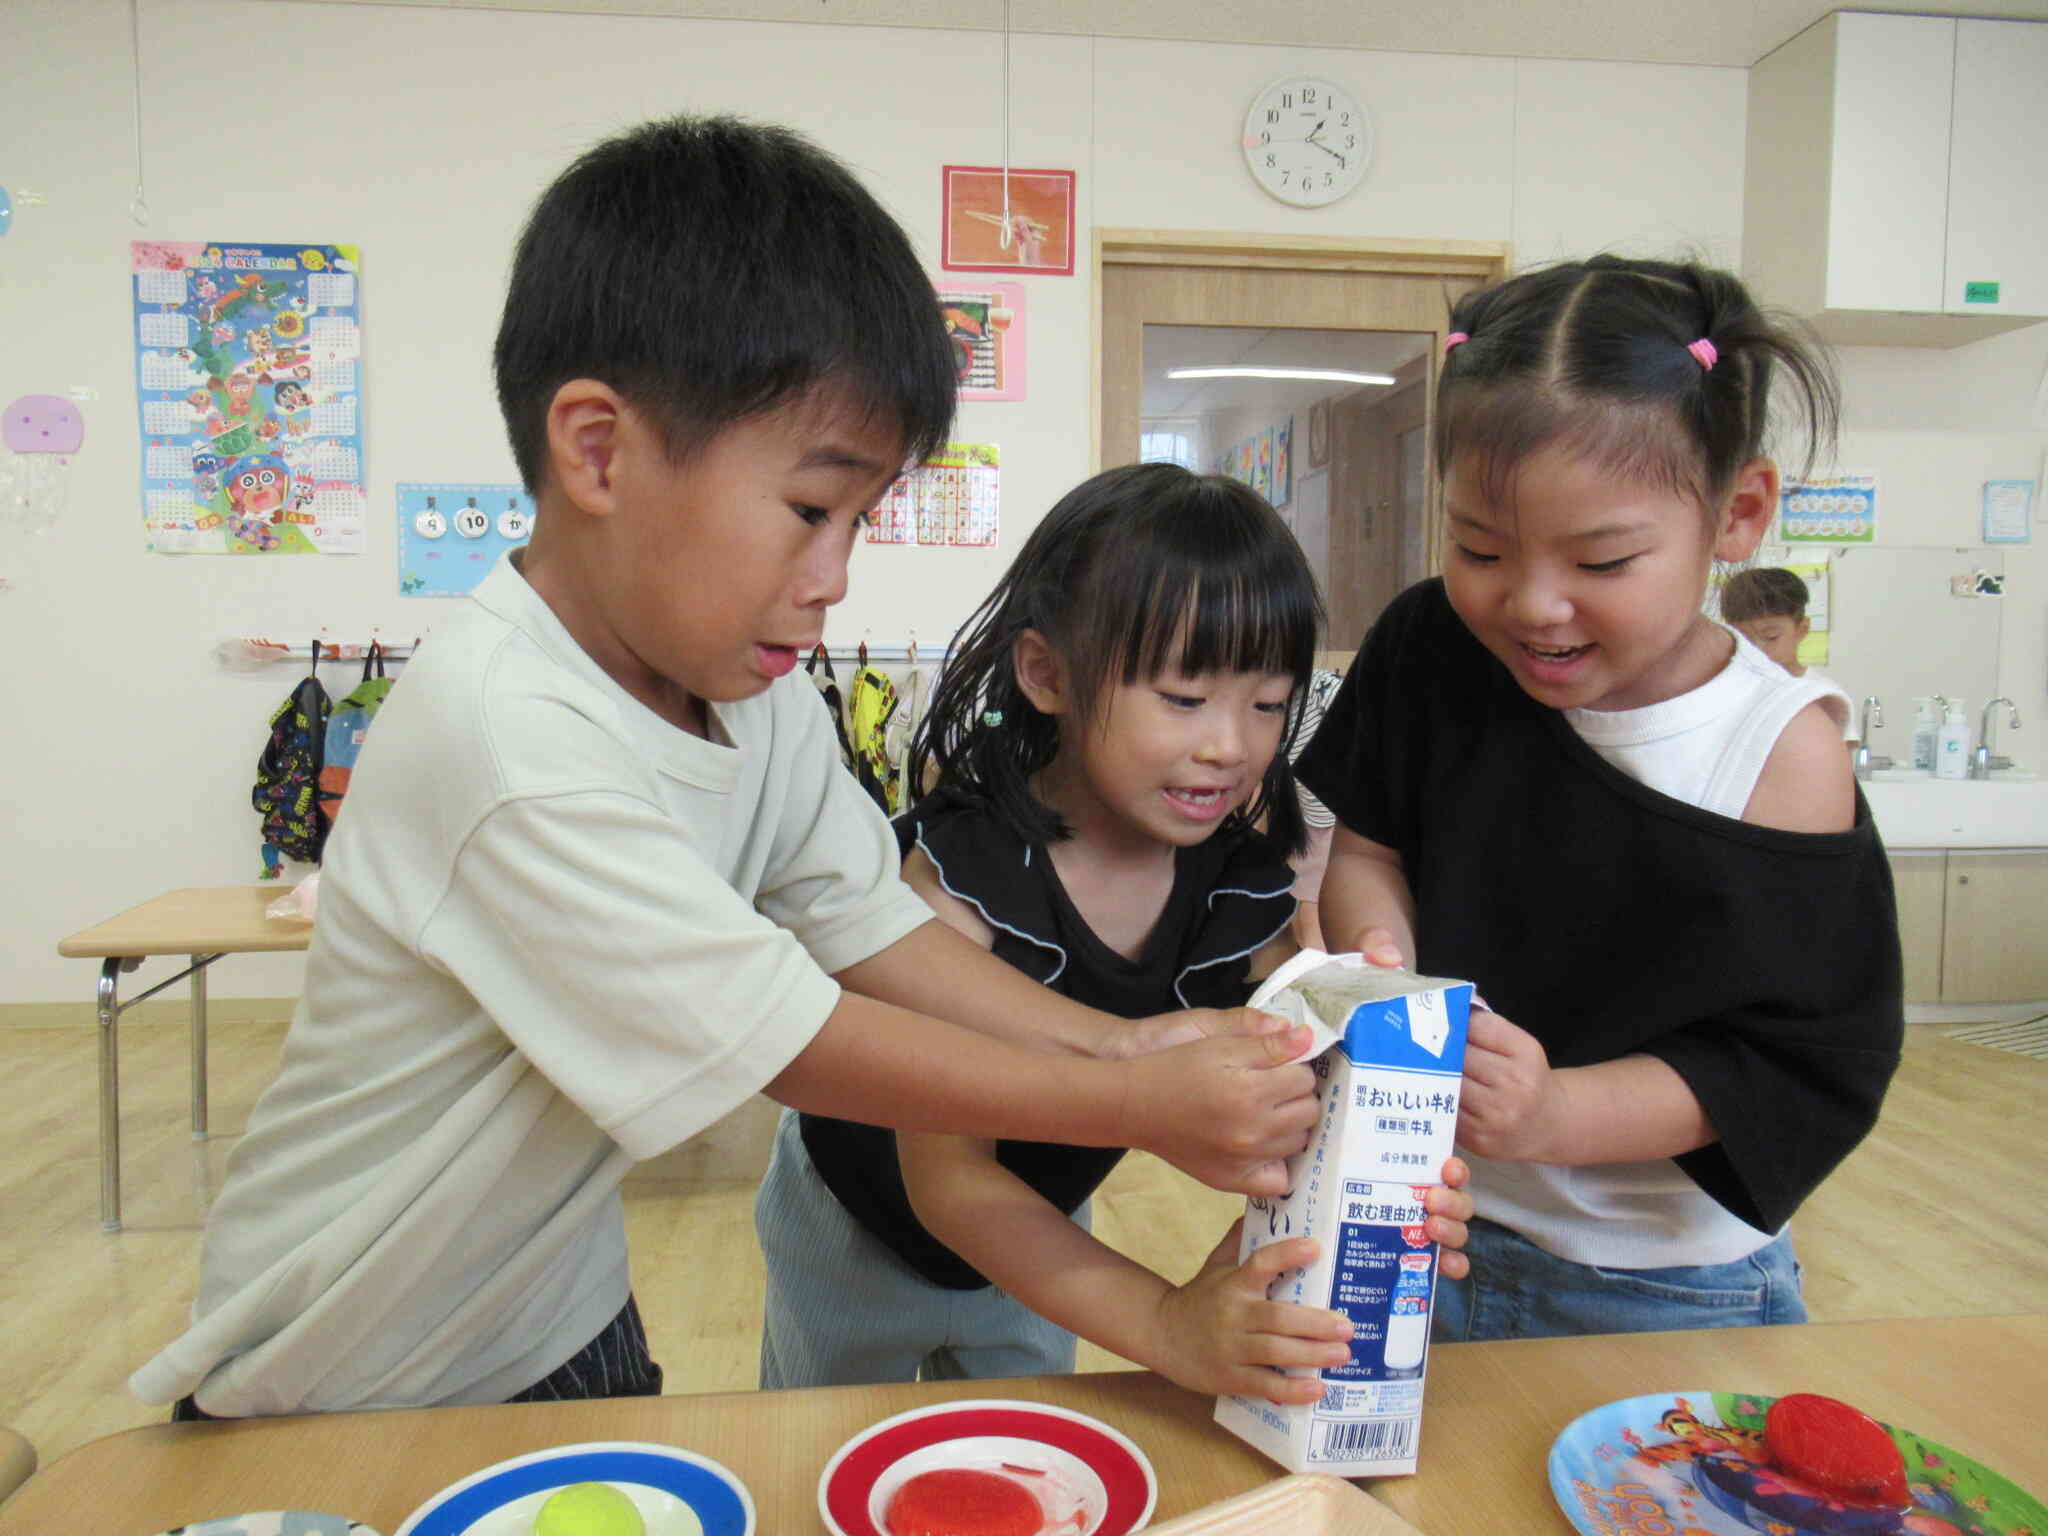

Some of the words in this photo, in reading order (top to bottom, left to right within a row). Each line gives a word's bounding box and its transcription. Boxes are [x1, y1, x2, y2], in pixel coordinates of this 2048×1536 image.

[1282, 94, 1292, 109] 11
[1303, 89, 1316, 104] 12
[1327, 95, 1332, 111] 1
[1267, 109, 1279, 124] 10
[1341, 112, 1349, 127] 2
[1261, 131, 1271, 145] 9
[1345, 134, 1355, 150] 3
[1266, 154, 1275, 168] 8
[1282, 170, 1290, 185] 7
[1302, 176, 1312, 192] 6
[1323, 172, 1333, 187] 5
[467, 515, 484, 529] 10
[1369, 1088, 1456, 1114] おいしい牛乳
[1411, 1120, 1433, 1136] 牛乳
[1348, 1228, 1358, 1237] 01
[1407, 1230, 1424, 1241] NE
[1342, 1272, 1353, 1281] 02
